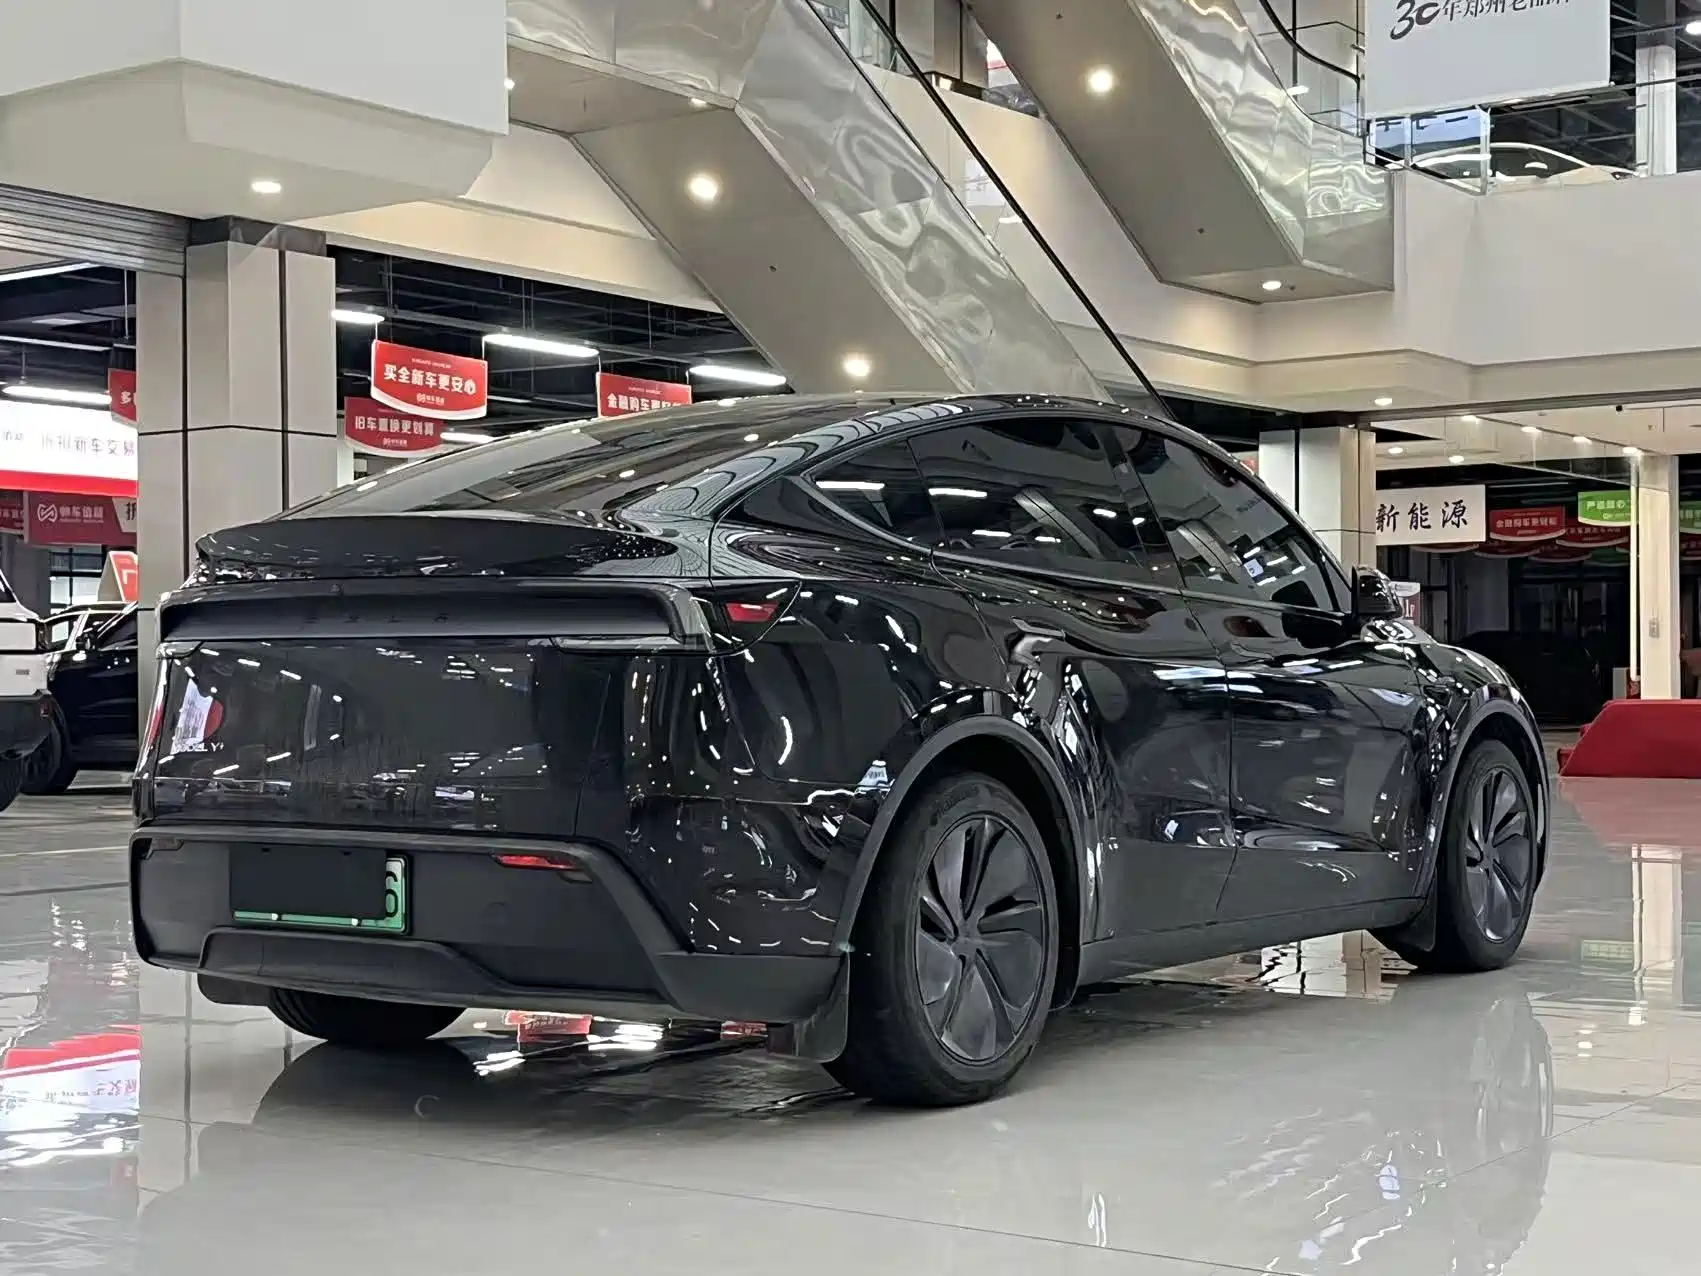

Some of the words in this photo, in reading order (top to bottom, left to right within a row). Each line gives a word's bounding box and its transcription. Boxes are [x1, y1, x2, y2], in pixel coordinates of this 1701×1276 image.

[383, 363, 477, 395] 买全新车更安心
[120, 391, 137, 406] 多
[607, 392, 682, 412] 金融购车更轻
[355, 415, 435, 436] 旧车置换更划算
[1375, 499, 1468, 533] 新能源
